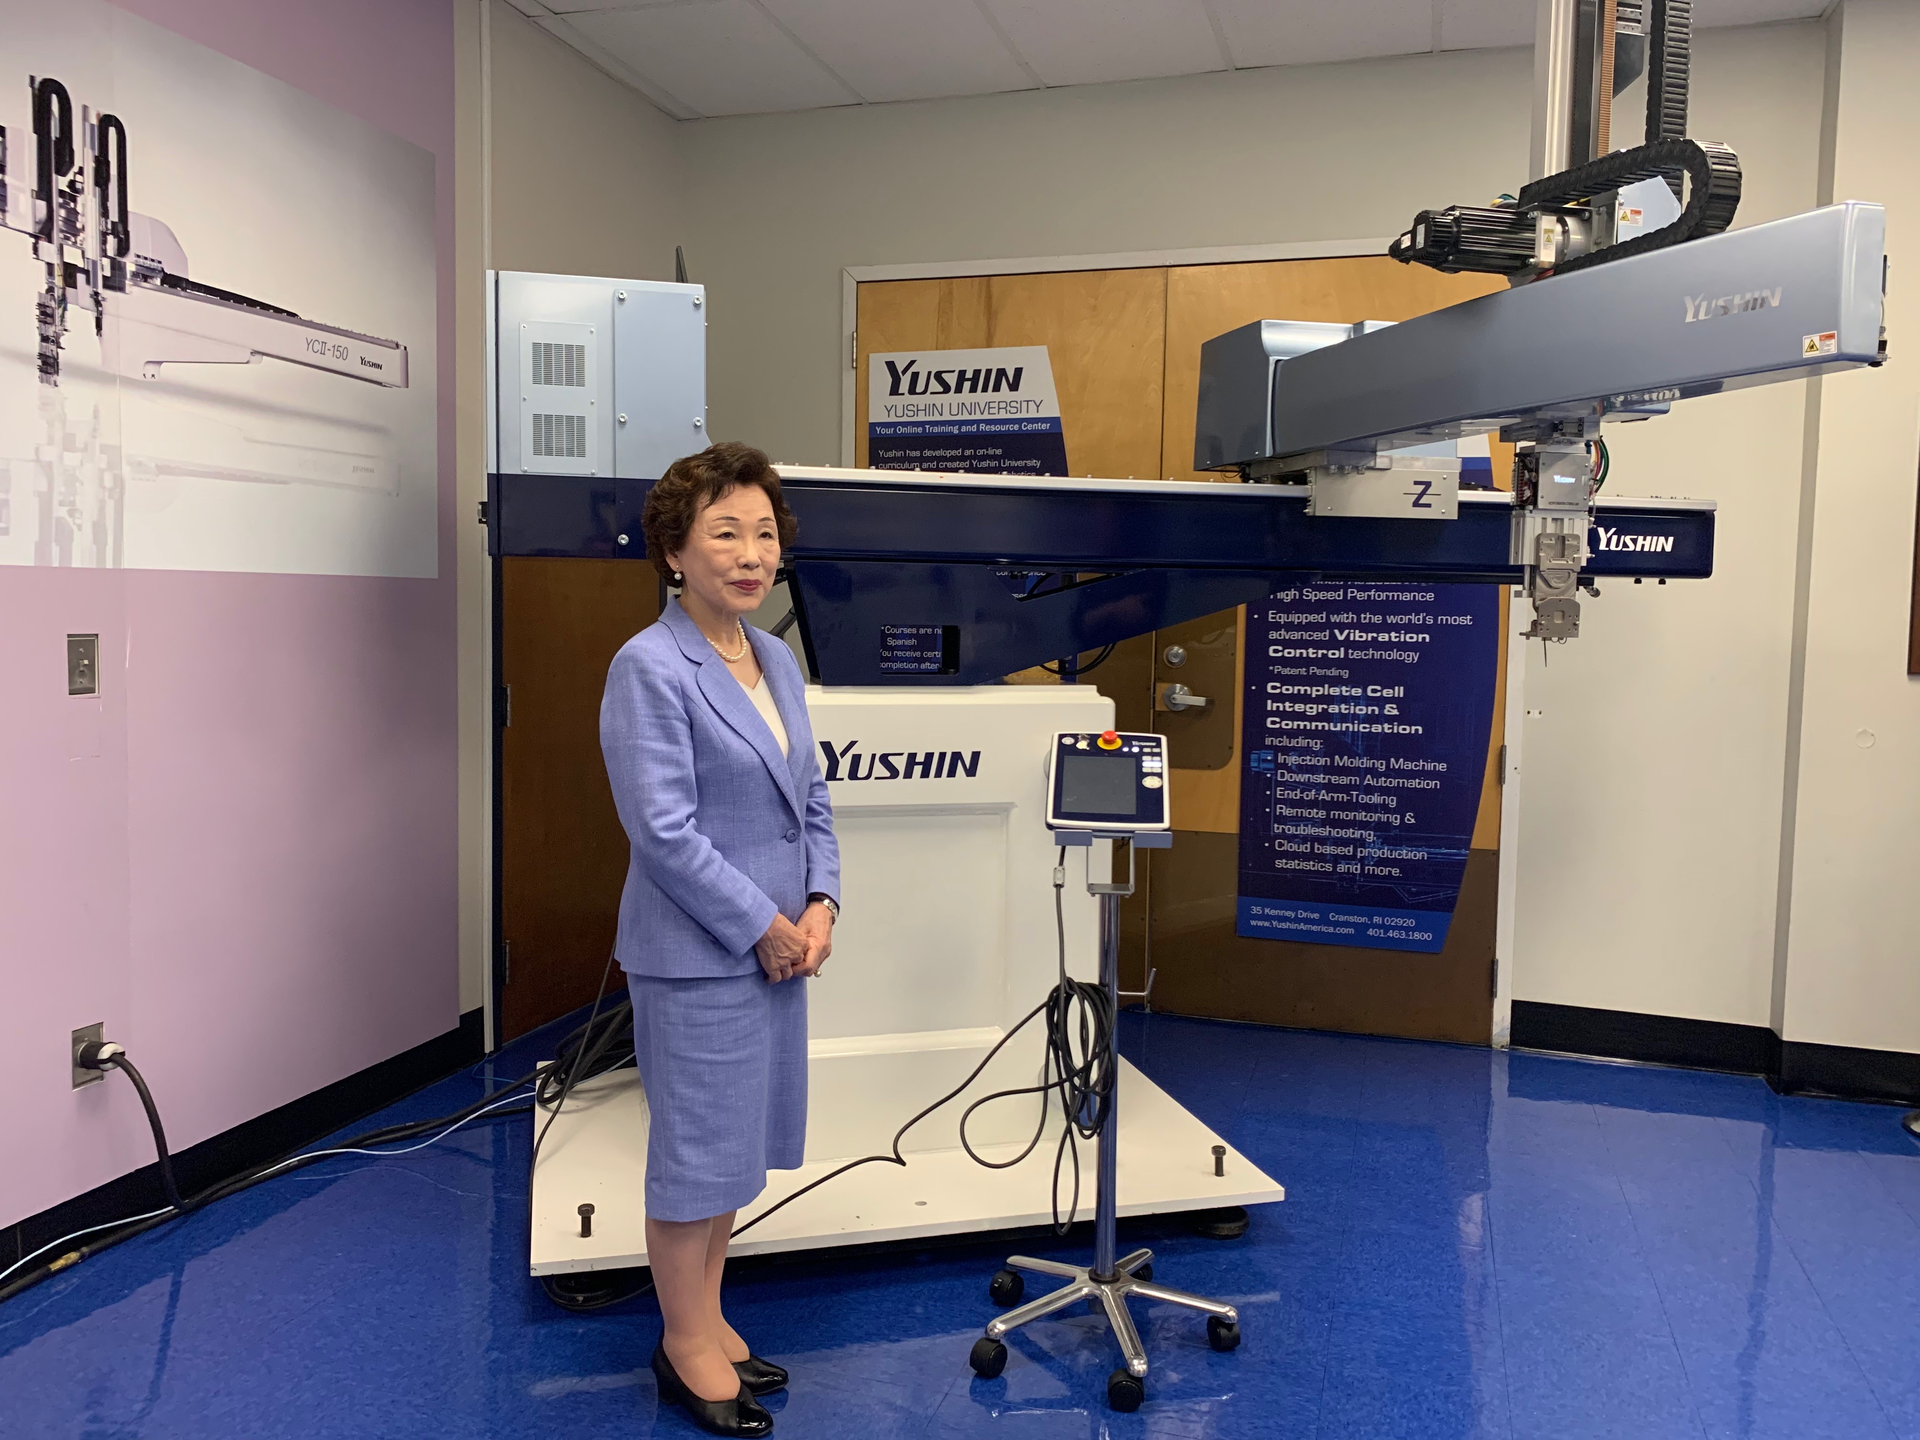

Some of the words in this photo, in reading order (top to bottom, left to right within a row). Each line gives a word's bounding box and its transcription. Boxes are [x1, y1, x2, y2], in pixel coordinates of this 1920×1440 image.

[1684, 286, 1783, 324] YUSHIN
[360, 356, 383, 370] YUSHIN
[884, 359, 1024, 396] YUSHIN
[884, 403, 943, 418] YUSHIN
[949, 399, 1044, 416] UNIVERSITY
[875, 426, 894, 435] Your
[896, 424, 923, 434] Online
[924, 424, 959, 434] Training
[961, 423, 977, 432] and
[979, 422, 1019, 432] Resource
[1021, 421, 1051, 431] Center
[878, 449, 904, 458] Yushin
[906, 448, 921, 458] has
[922, 448, 962, 459] developed
[976, 447, 1003, 456] on-line
[878, 460, 920, 470] curriculum
[921, 460, 937, 468] and
[938, 459, 970, 468] created
[971, 458, 999, 468] Yushin
[1001, 458, 1041, 469] University
[1412, 480, 1432, 508] Z
[1598, 528, 1674, 553] YUSHIN
[1303, 588, 1343, 603] Speed
[1347, 589, 1435, 601] Performance
[1268, 610, 1326, 625] Equipped
[1330, 611, 1357, 623] with
[1360, 612, 1382, 624] the
[1386, 612, 1433, 625] world's
[1437, 614, 1473, 625] most
[886, 638, 917, 647] Spanish
[1268, 629, 1329, 641] advanced
[1333, 629, 1430, 642] Vibration
[1268, 645, 1344, 658] Control
[1348, 648, 1420, 663] technology
[920, 662, 940, 670] after
[1310, 666, 1349, 678] Pending
[1266, 682, 1362, 698] Complete
[1366, 685, 1404, 698] Cell
[1266, 700, 1379, 715] Integration
[1383, 704, 1399, 715] &
[1266, 717, 1423, 735] Communication
[1265, 735, 1324, 750] including:
[818, 740, 981, 781] YUSHIN
[1277, 753, 1330, 767] Injection
[1334, 755, 1386, 771] Molding
[1390, 758, 1447, 772] Machine
[1277, 770, 1360, 785] Downstream
[1363, 774, 1440, 789] Automation
[1276, 787, 1397, 808] End-of-Arm-Tooling
[1276, 805, 1327, 819] Remote
[1330, 809, 1400, 825] monitoring
[1404, 812, 1416, 824] &
[1274, 839, 1311, 853] Cloud
[1314, 843, 1354, 856] based
[1356, 847, 1428, 863] production
[1274, 859, 1333, 872] statistics
[1336, 863, 1361, 874] and
[1364, 866, 1402, 877] more.
[1250, 906, 1263, 915] 35
[1264, 907, 1296, 919] Kenney
[1297, 909, 1320, 920] Drive
[1373, 915, 1382, 925] RI
[1384, 916, 1416, 927] 02920
[1250, 918, 1355, 935] www.YushinAmerica.com
[1367, 928, 1433, 941] 401.463.1800
